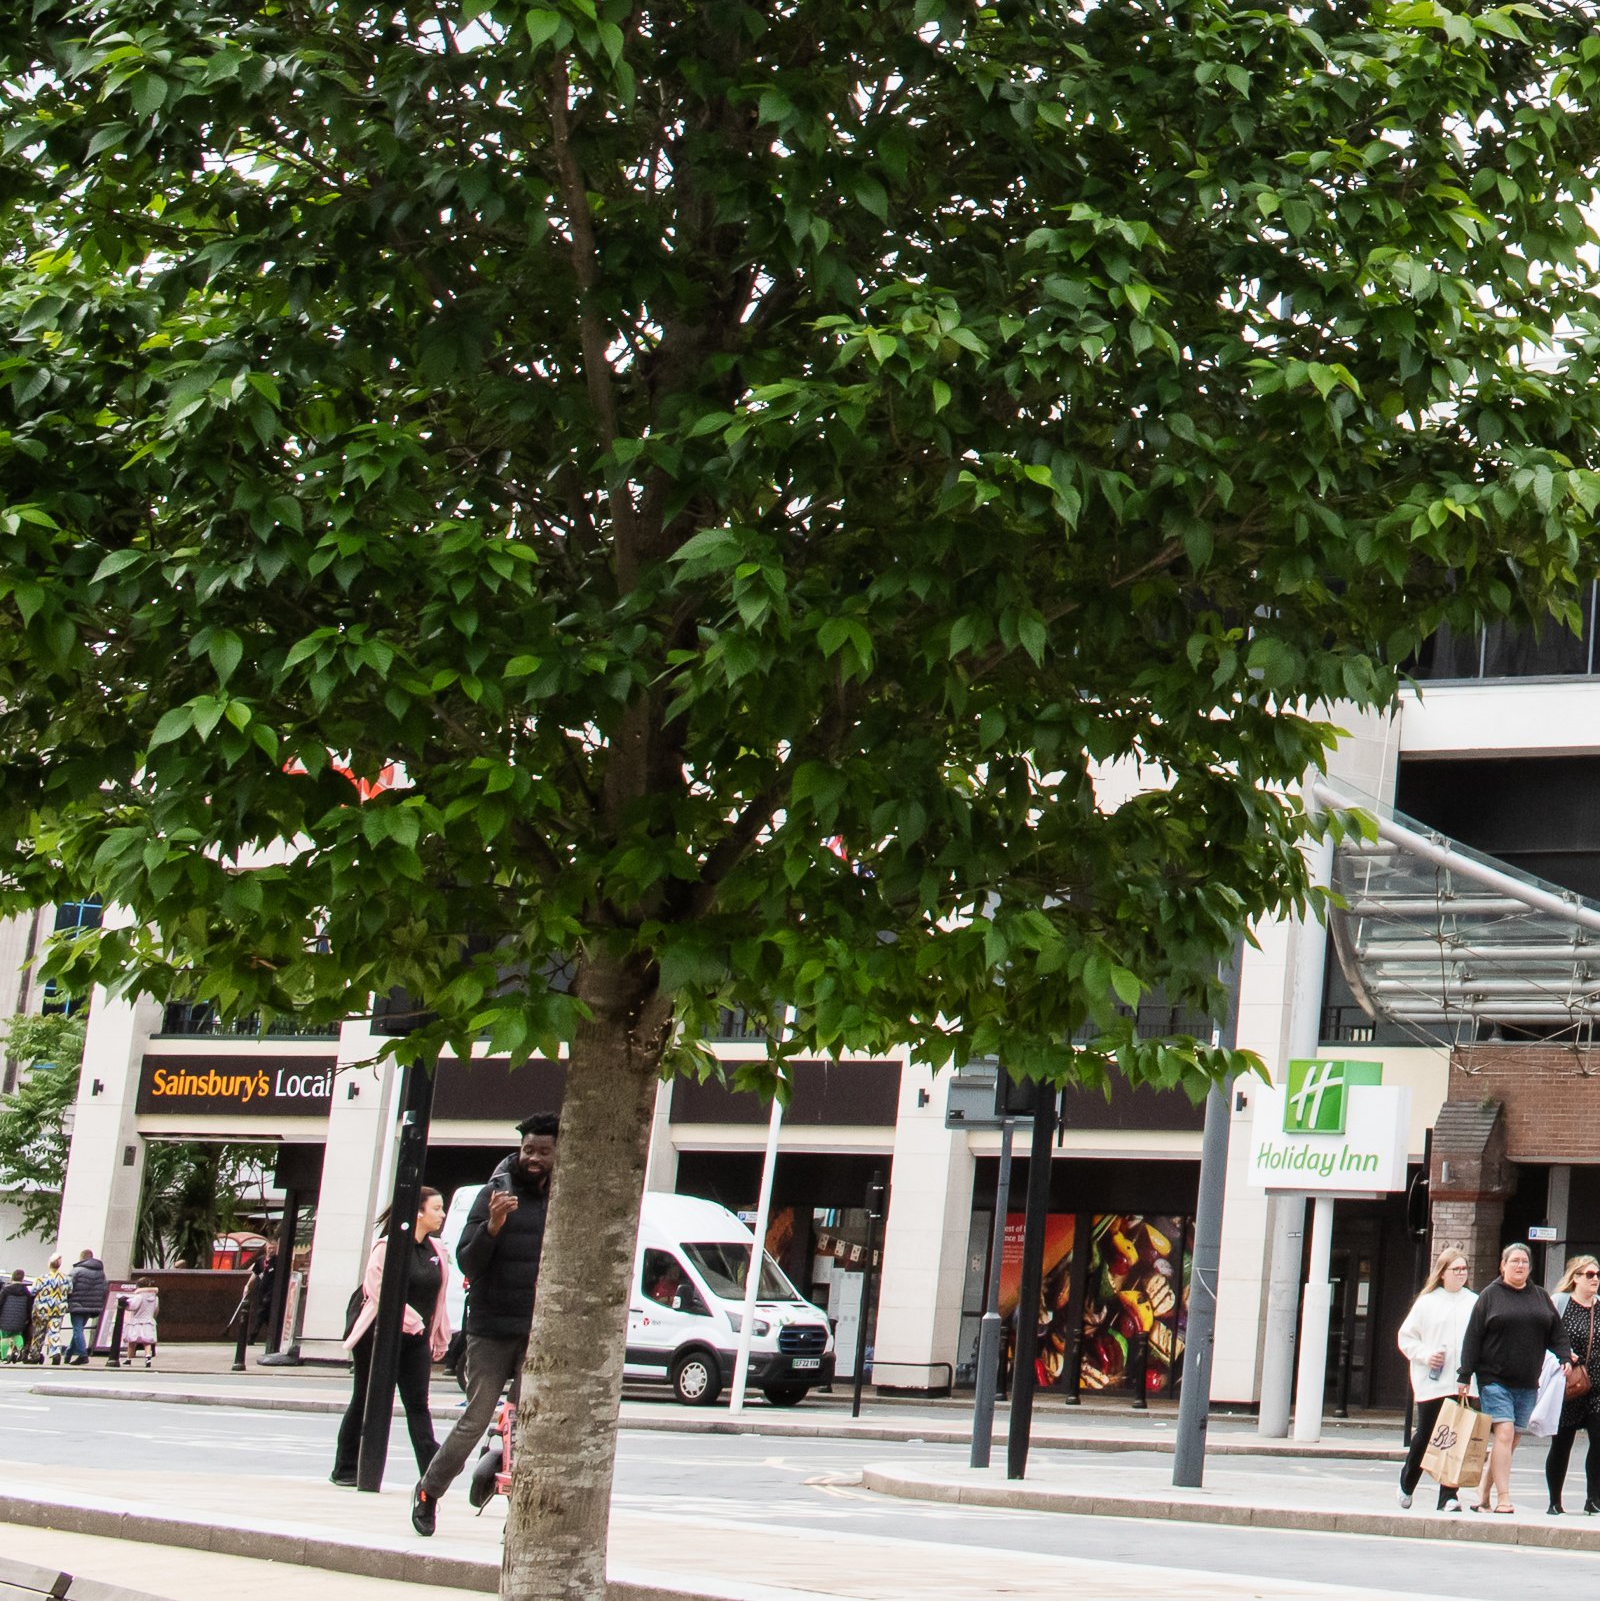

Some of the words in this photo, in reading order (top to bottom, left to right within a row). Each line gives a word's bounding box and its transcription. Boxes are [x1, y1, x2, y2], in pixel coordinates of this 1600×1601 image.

[152, 1069, 270, 1102] Sainsbury's
[275, 1067, 332, 1097] Local
[1257, 1141, 1336, 1177] Holiday
[1339, 1144, 1380, 1172] Inn
